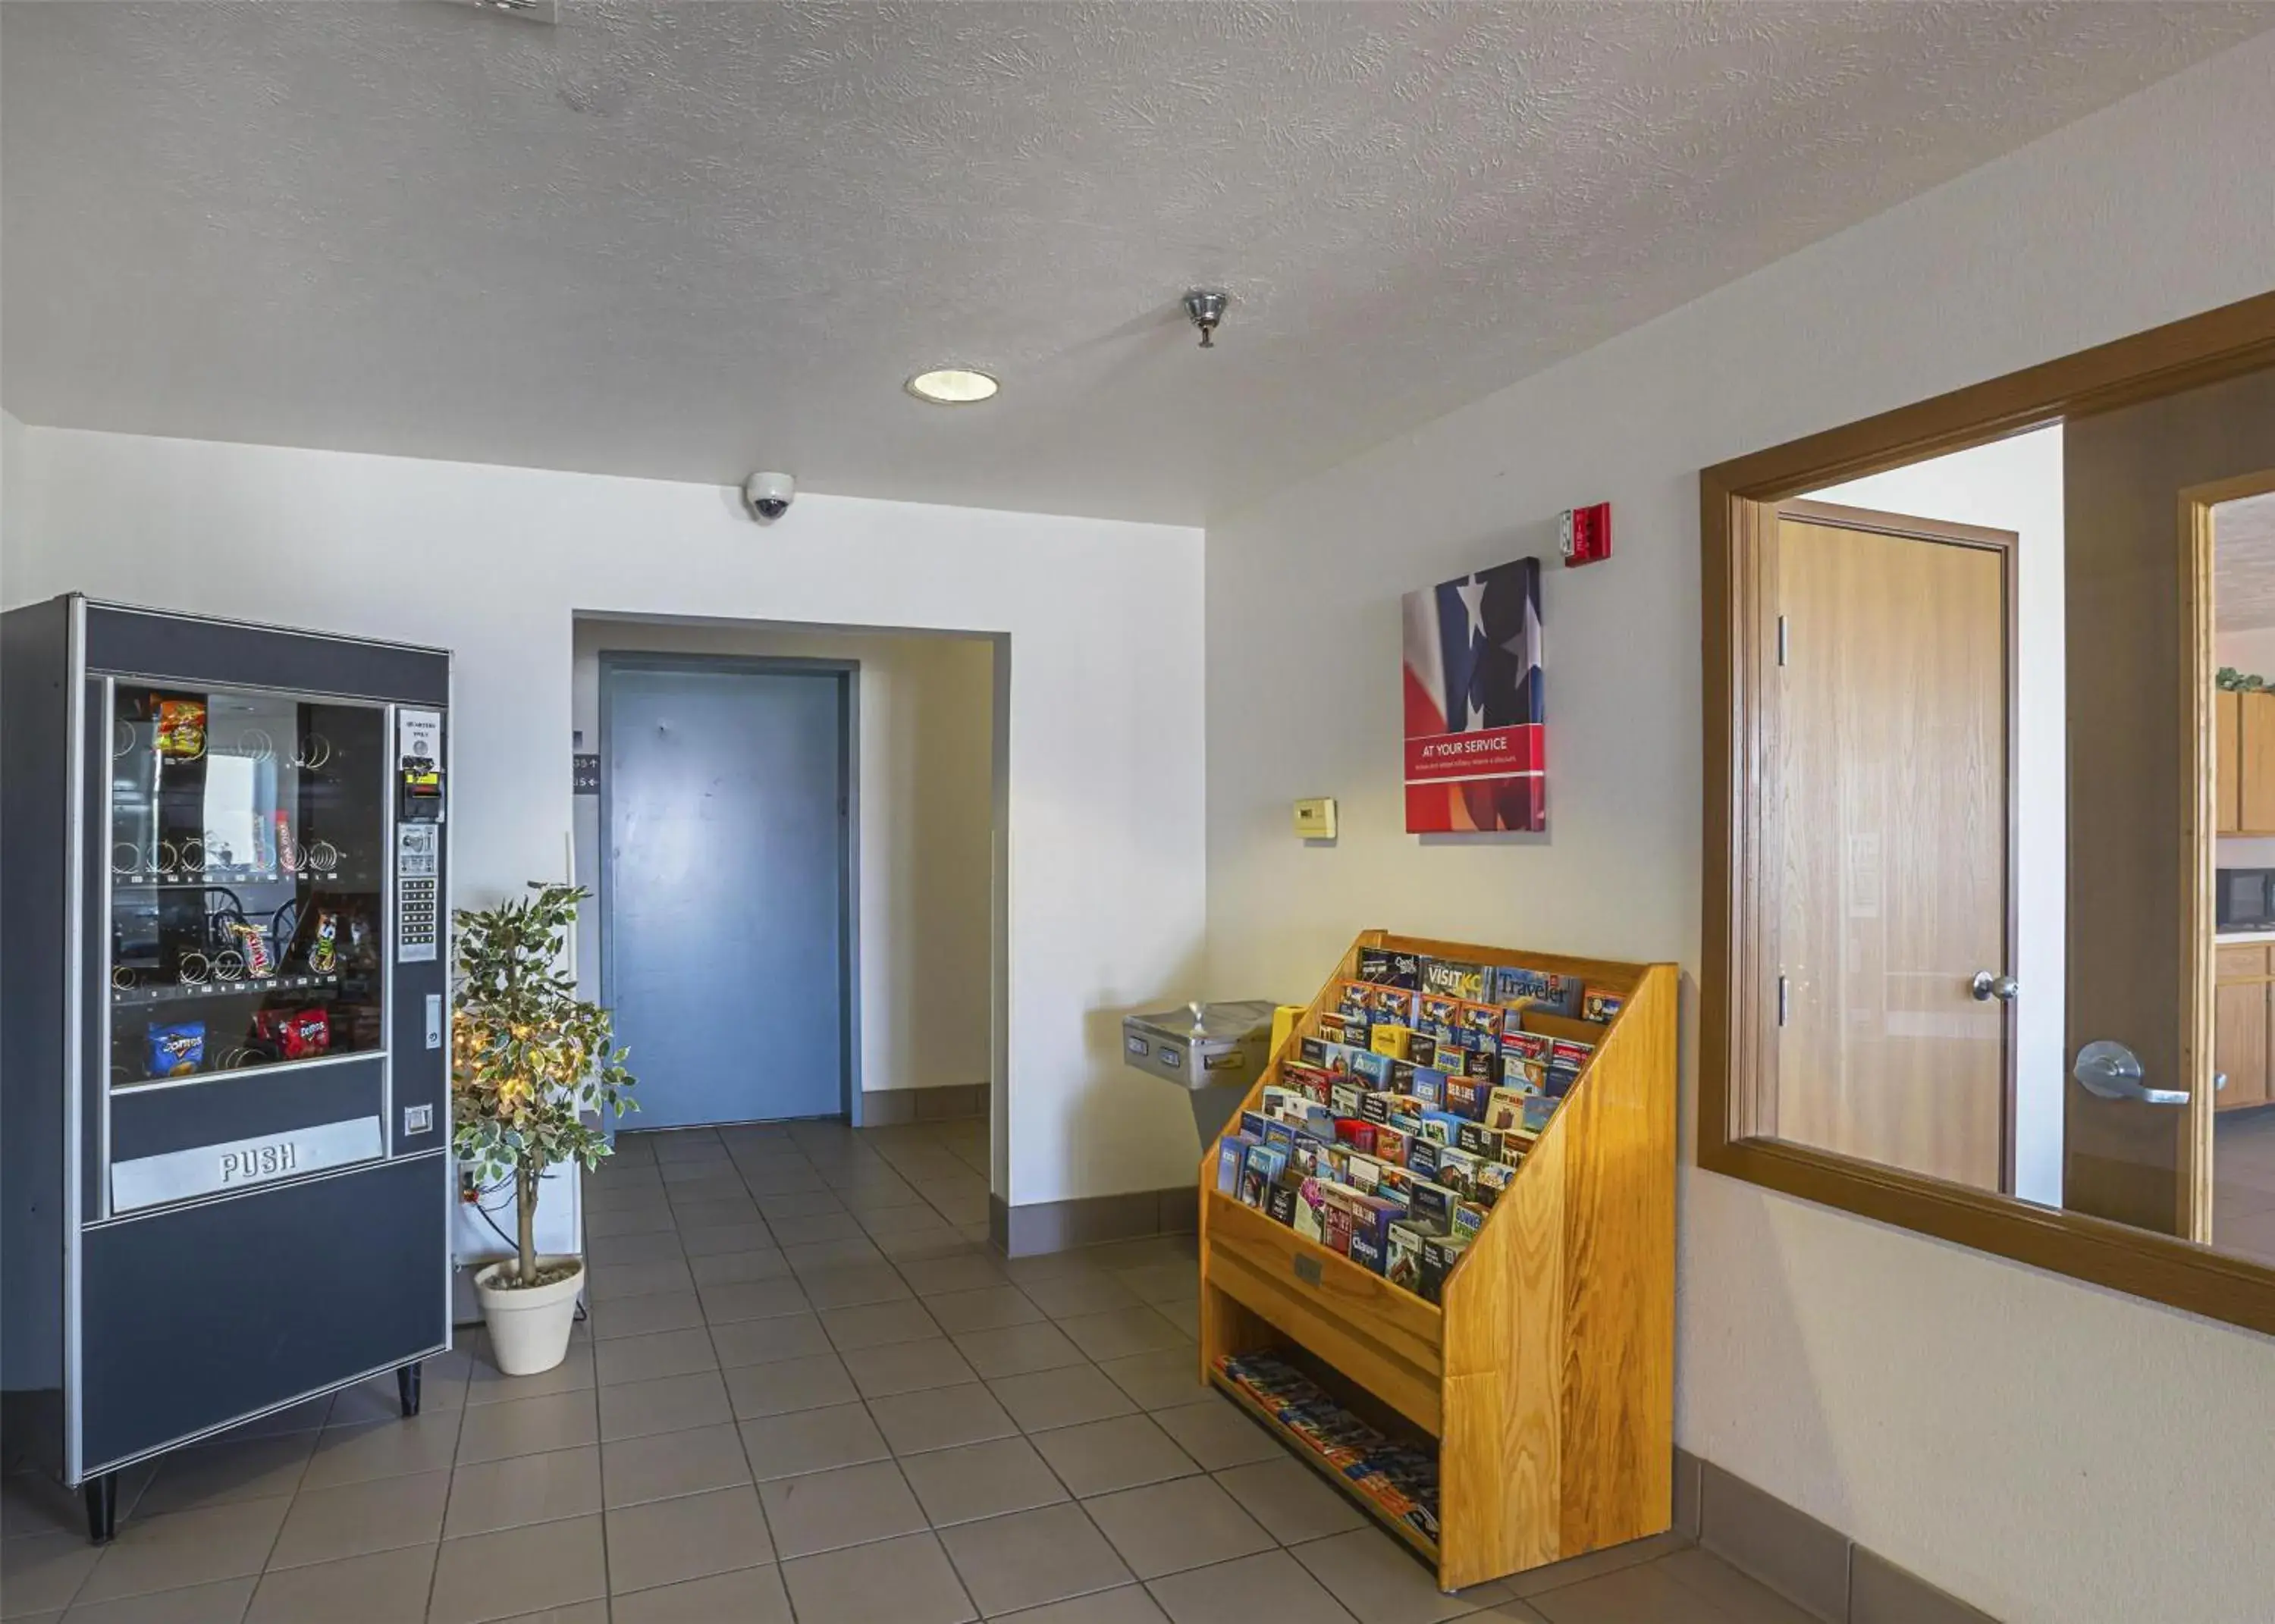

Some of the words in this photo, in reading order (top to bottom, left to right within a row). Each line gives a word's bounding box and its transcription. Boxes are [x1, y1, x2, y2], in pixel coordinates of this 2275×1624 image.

[1423, 745, 1434, 757] AT
[1436, 741, 1463, 756] YOUR
[1464, 737, 1508, 753] SERVICE
[1499, 973, 1569, 1003] Traveler
[220, 1142, 297, 1183] PUSH
